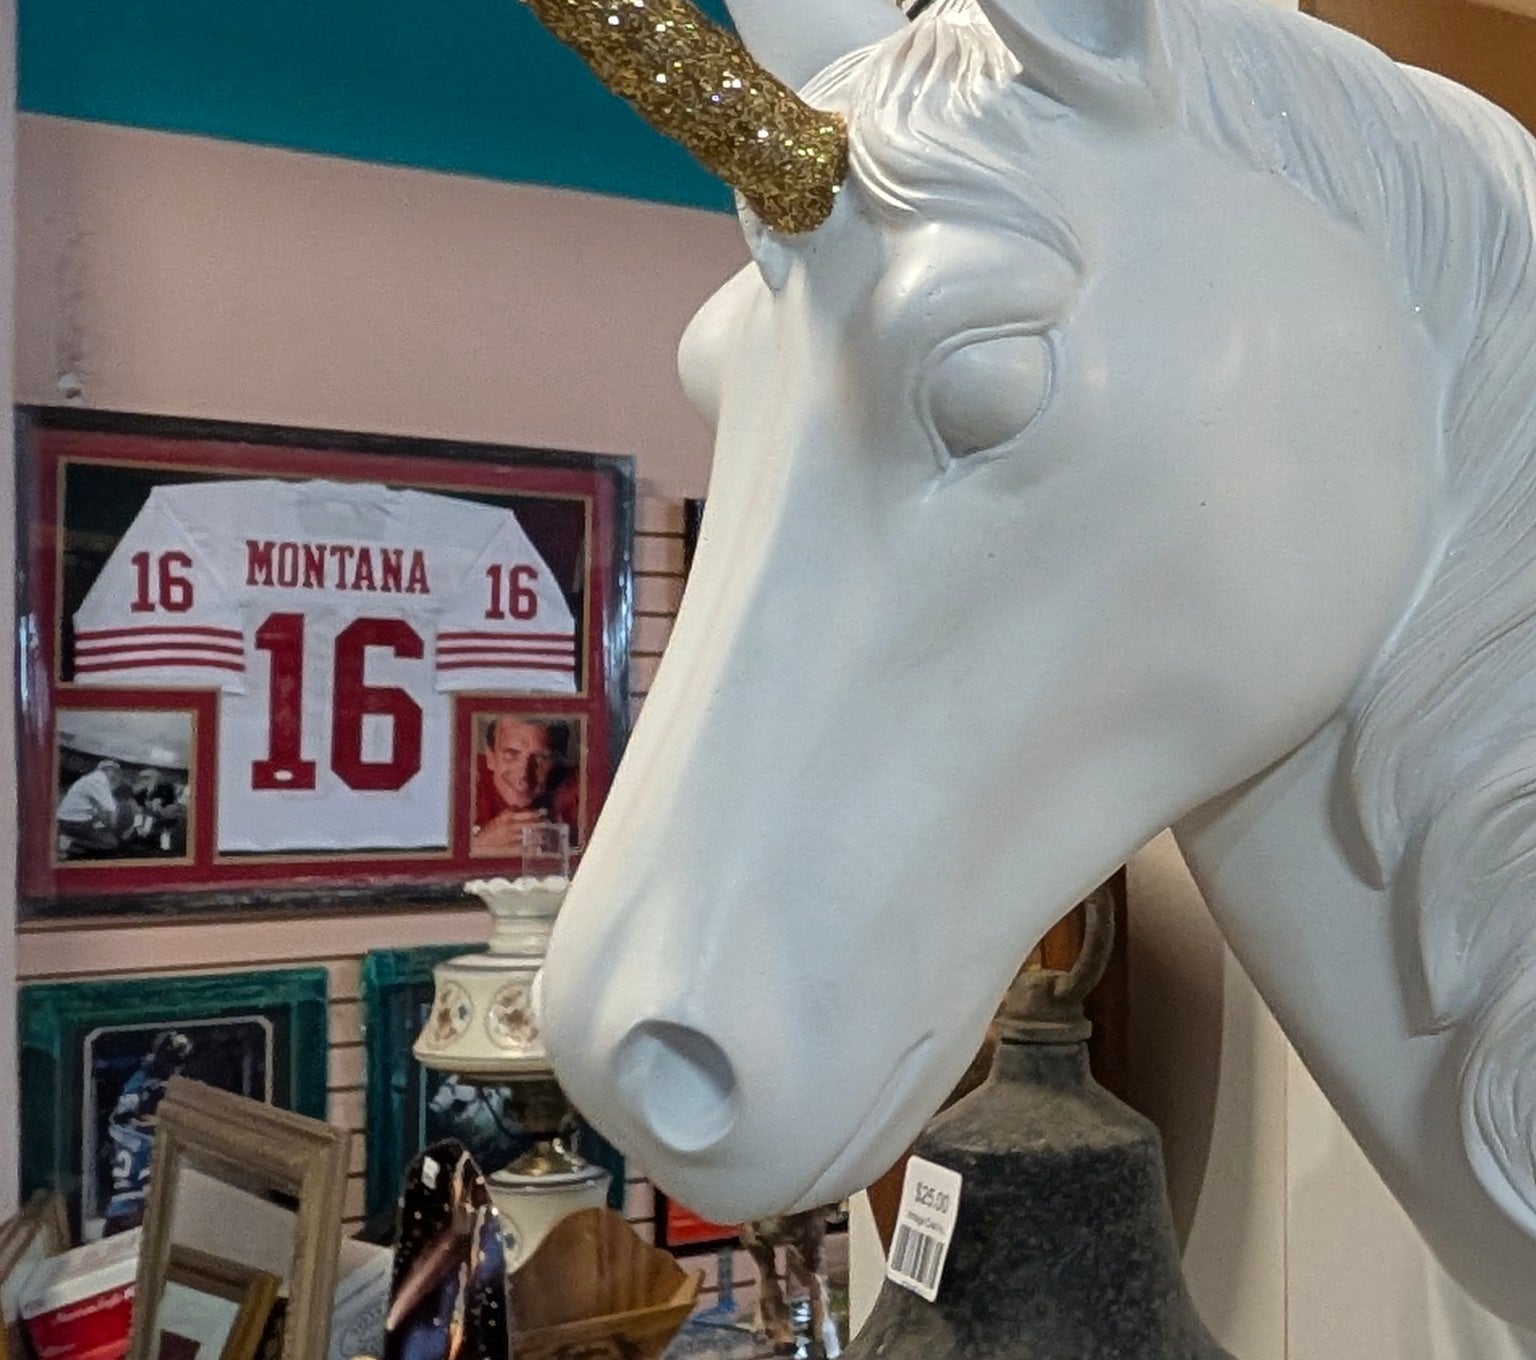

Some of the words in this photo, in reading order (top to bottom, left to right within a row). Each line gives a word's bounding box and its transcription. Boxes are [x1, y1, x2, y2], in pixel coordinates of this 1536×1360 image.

[130, 551, 194, 614] 16
[245, 539, 431, 595] MONTANA
[484, 563, 539, 621] 16
[251, 612, 424, 791] 16
